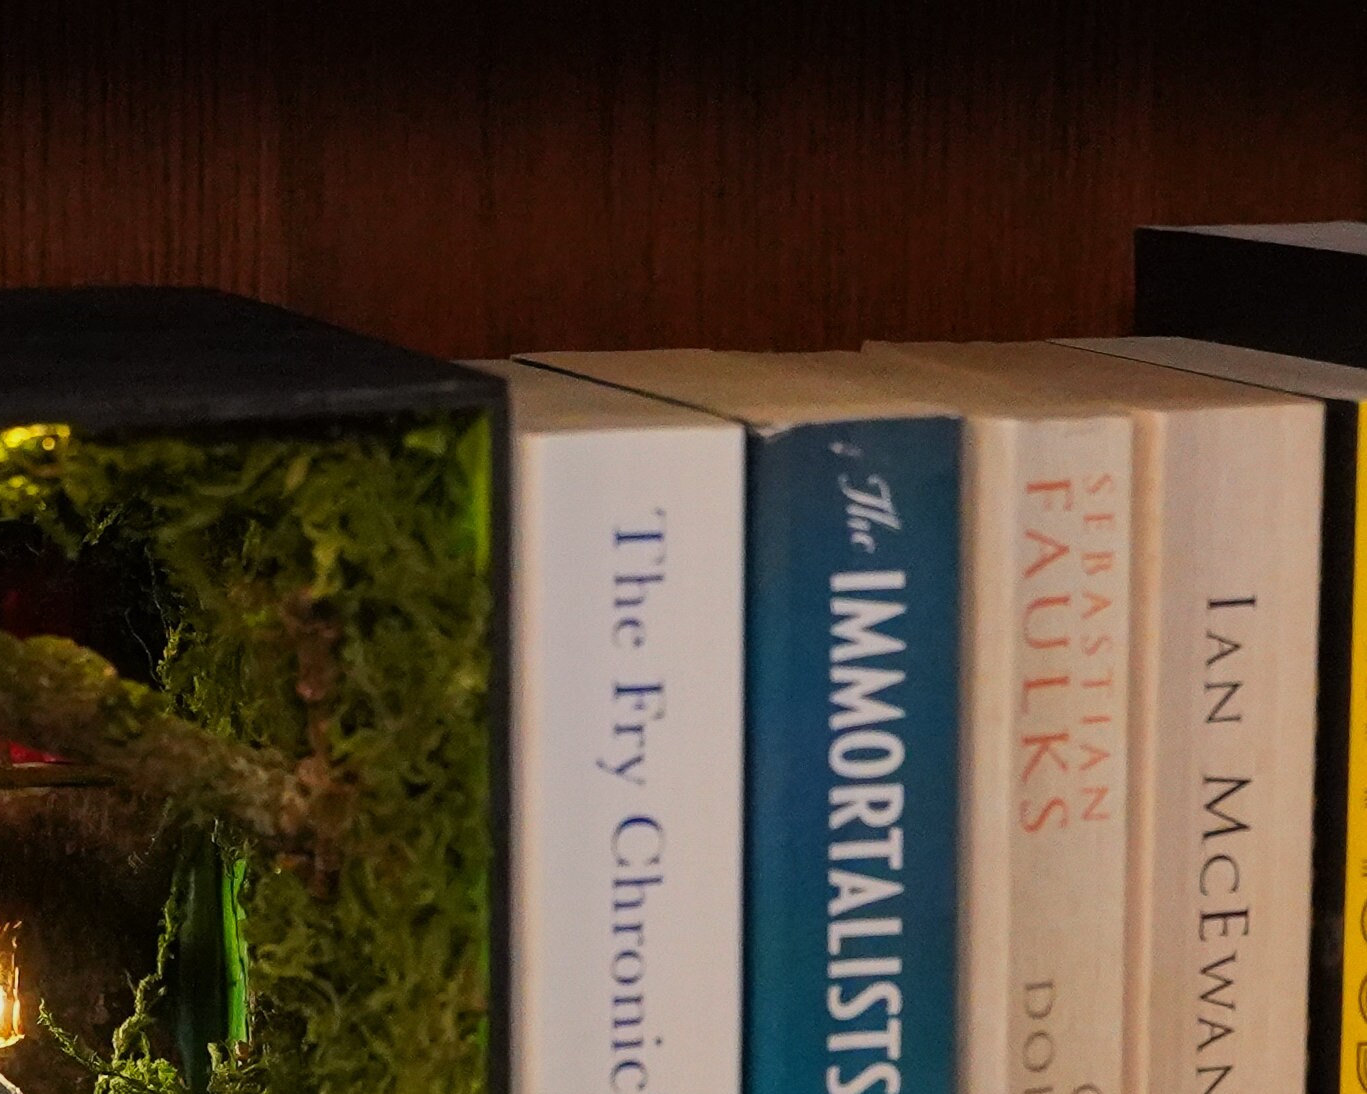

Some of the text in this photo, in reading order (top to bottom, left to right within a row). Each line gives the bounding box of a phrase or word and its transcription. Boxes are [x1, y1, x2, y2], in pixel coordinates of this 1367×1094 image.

[830, 442, 902, 553] The
[611, 507, 667, 649] The
[1019, 478, 1074, 833] FAULKS
[1079, 473, 1116, 822] SEBASTIAN
[1204, 594, 1257, 726] IAN
[595, 680, 665, 786] Fry
